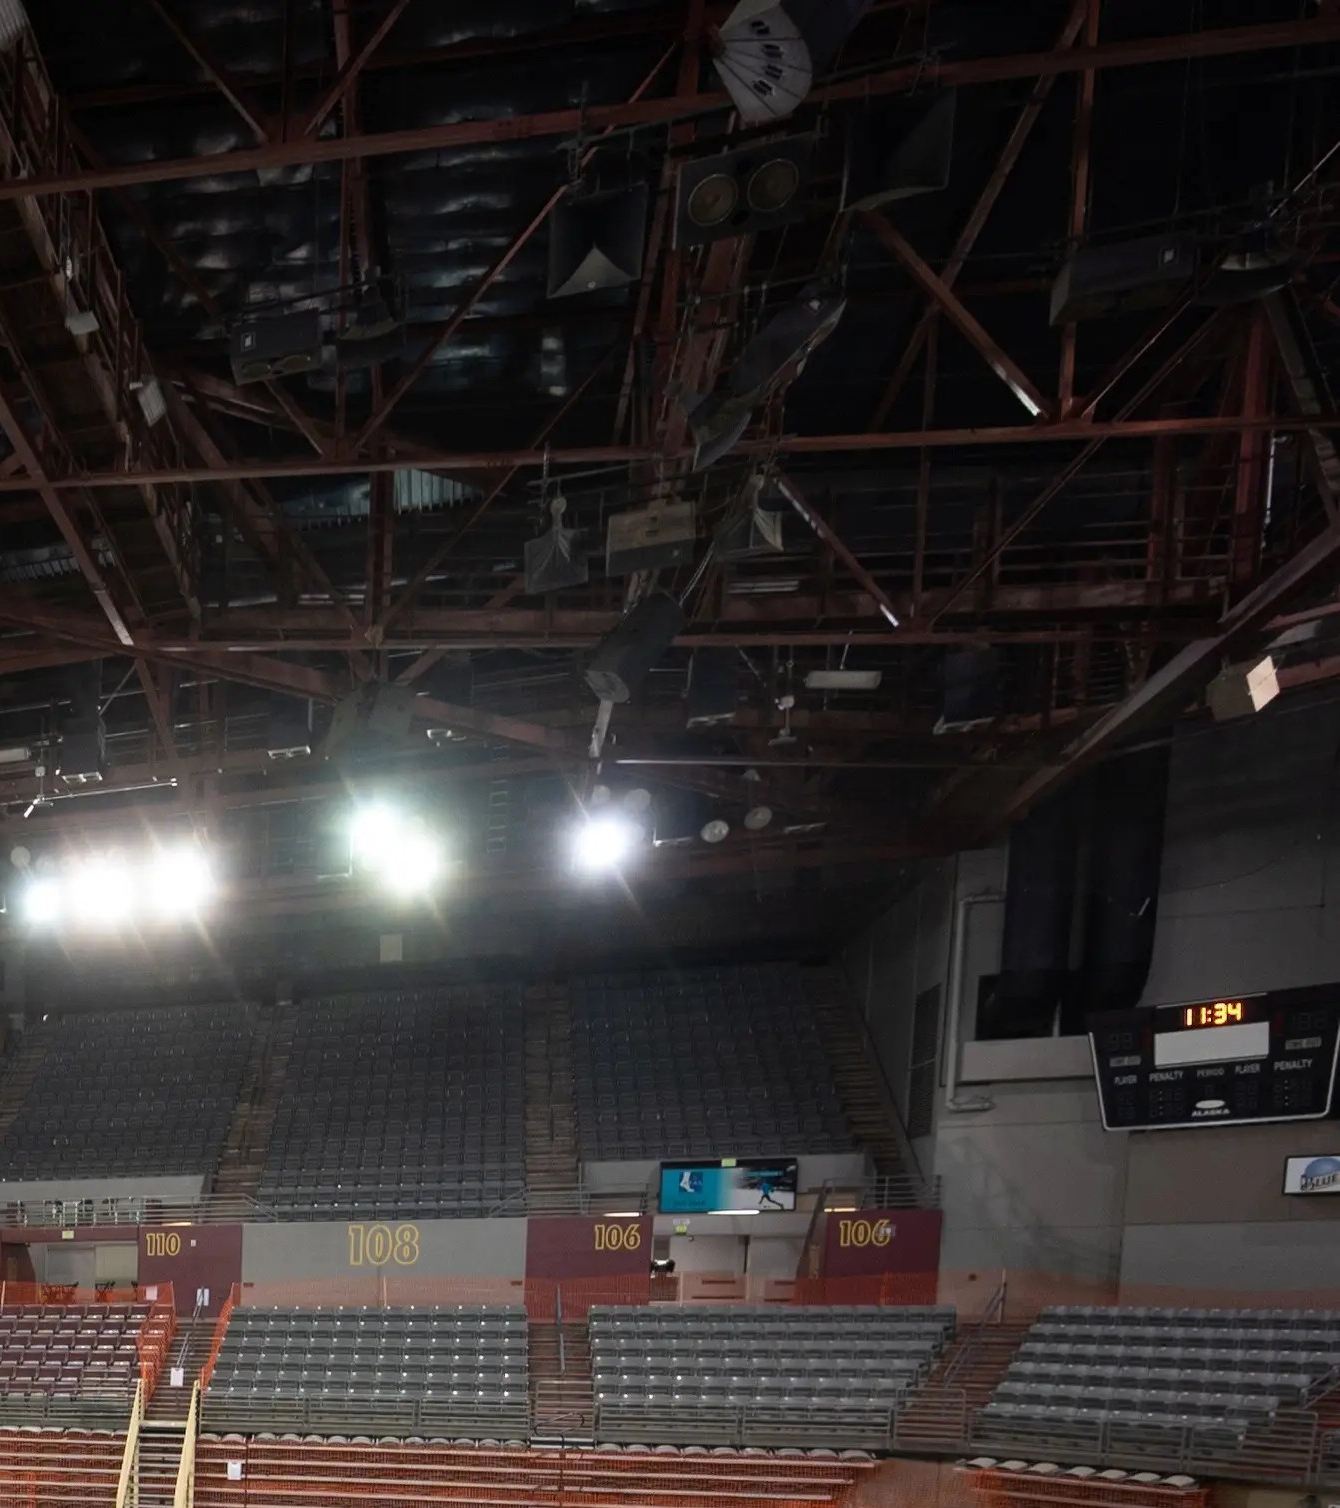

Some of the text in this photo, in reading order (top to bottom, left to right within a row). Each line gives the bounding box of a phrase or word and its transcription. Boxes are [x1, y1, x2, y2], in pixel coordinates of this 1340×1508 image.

[1186, 1002, 1243, 1027] 11:34
[1149, 1070, 1184, 1082] PENALTY
[1234, 1058, 1313, 1074] PLAYER PENALTY
[1190, 1107, 1231, 1118] ALASKA
[145, 1232, 182, 1257] 110
[348, 1223, 420, 1266] 108
[593, 1223, 642, 1251] 106
[839, 1219, 891, 1247] 106
